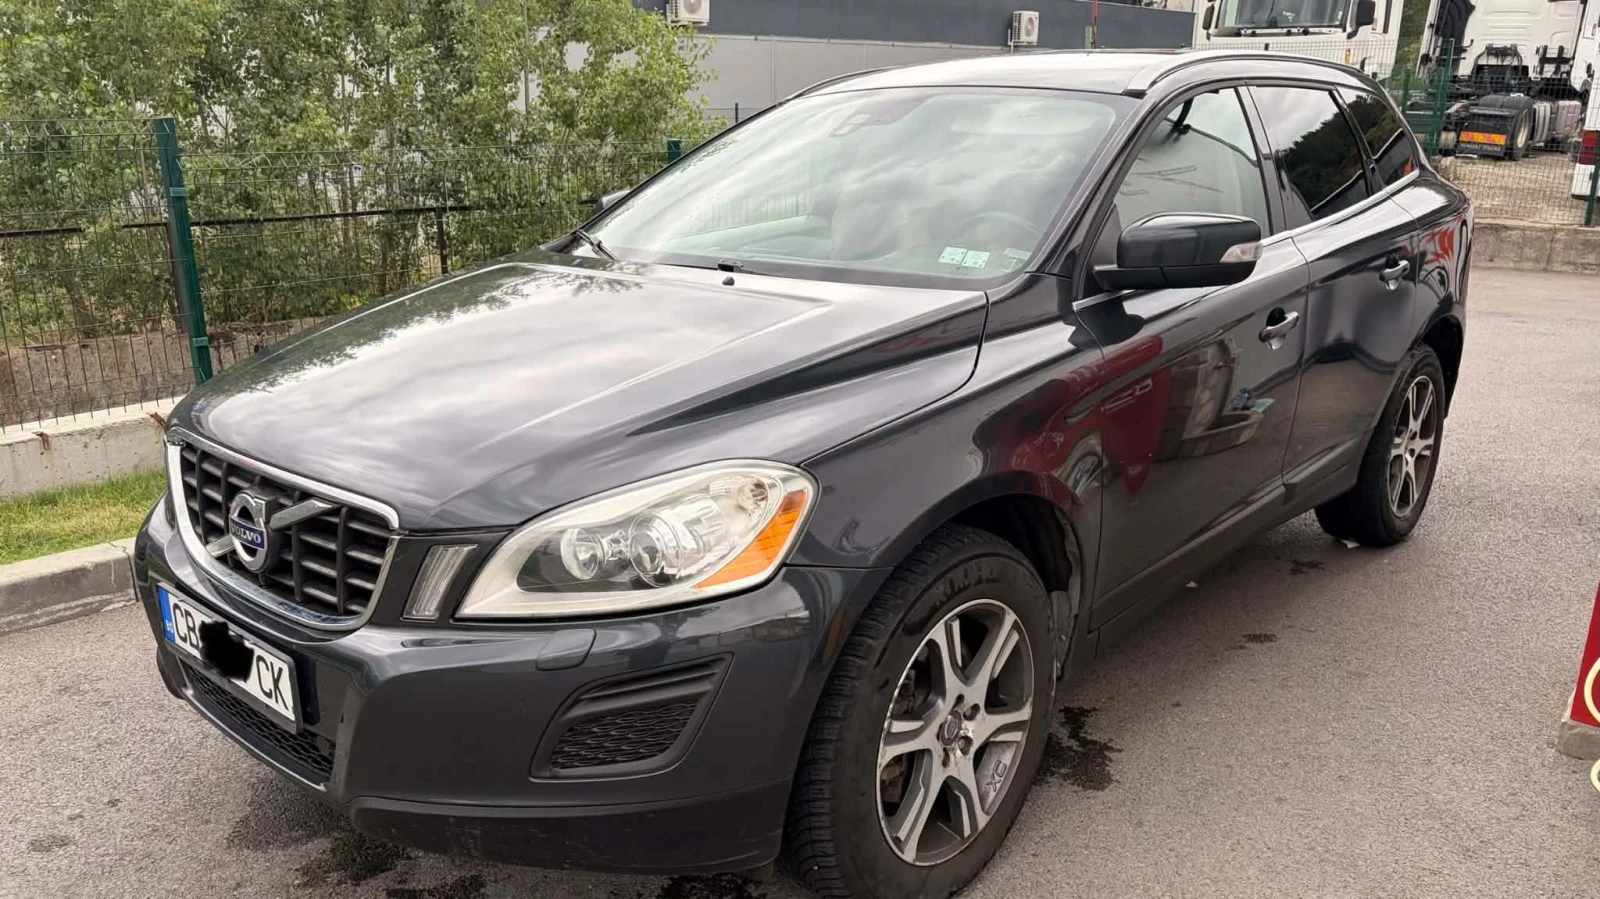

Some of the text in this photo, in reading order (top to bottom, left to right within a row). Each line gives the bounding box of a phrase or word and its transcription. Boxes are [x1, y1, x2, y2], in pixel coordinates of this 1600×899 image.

[231, 523, 261, 544] VOLVO
[173, 602, 289, 711] CB CK
